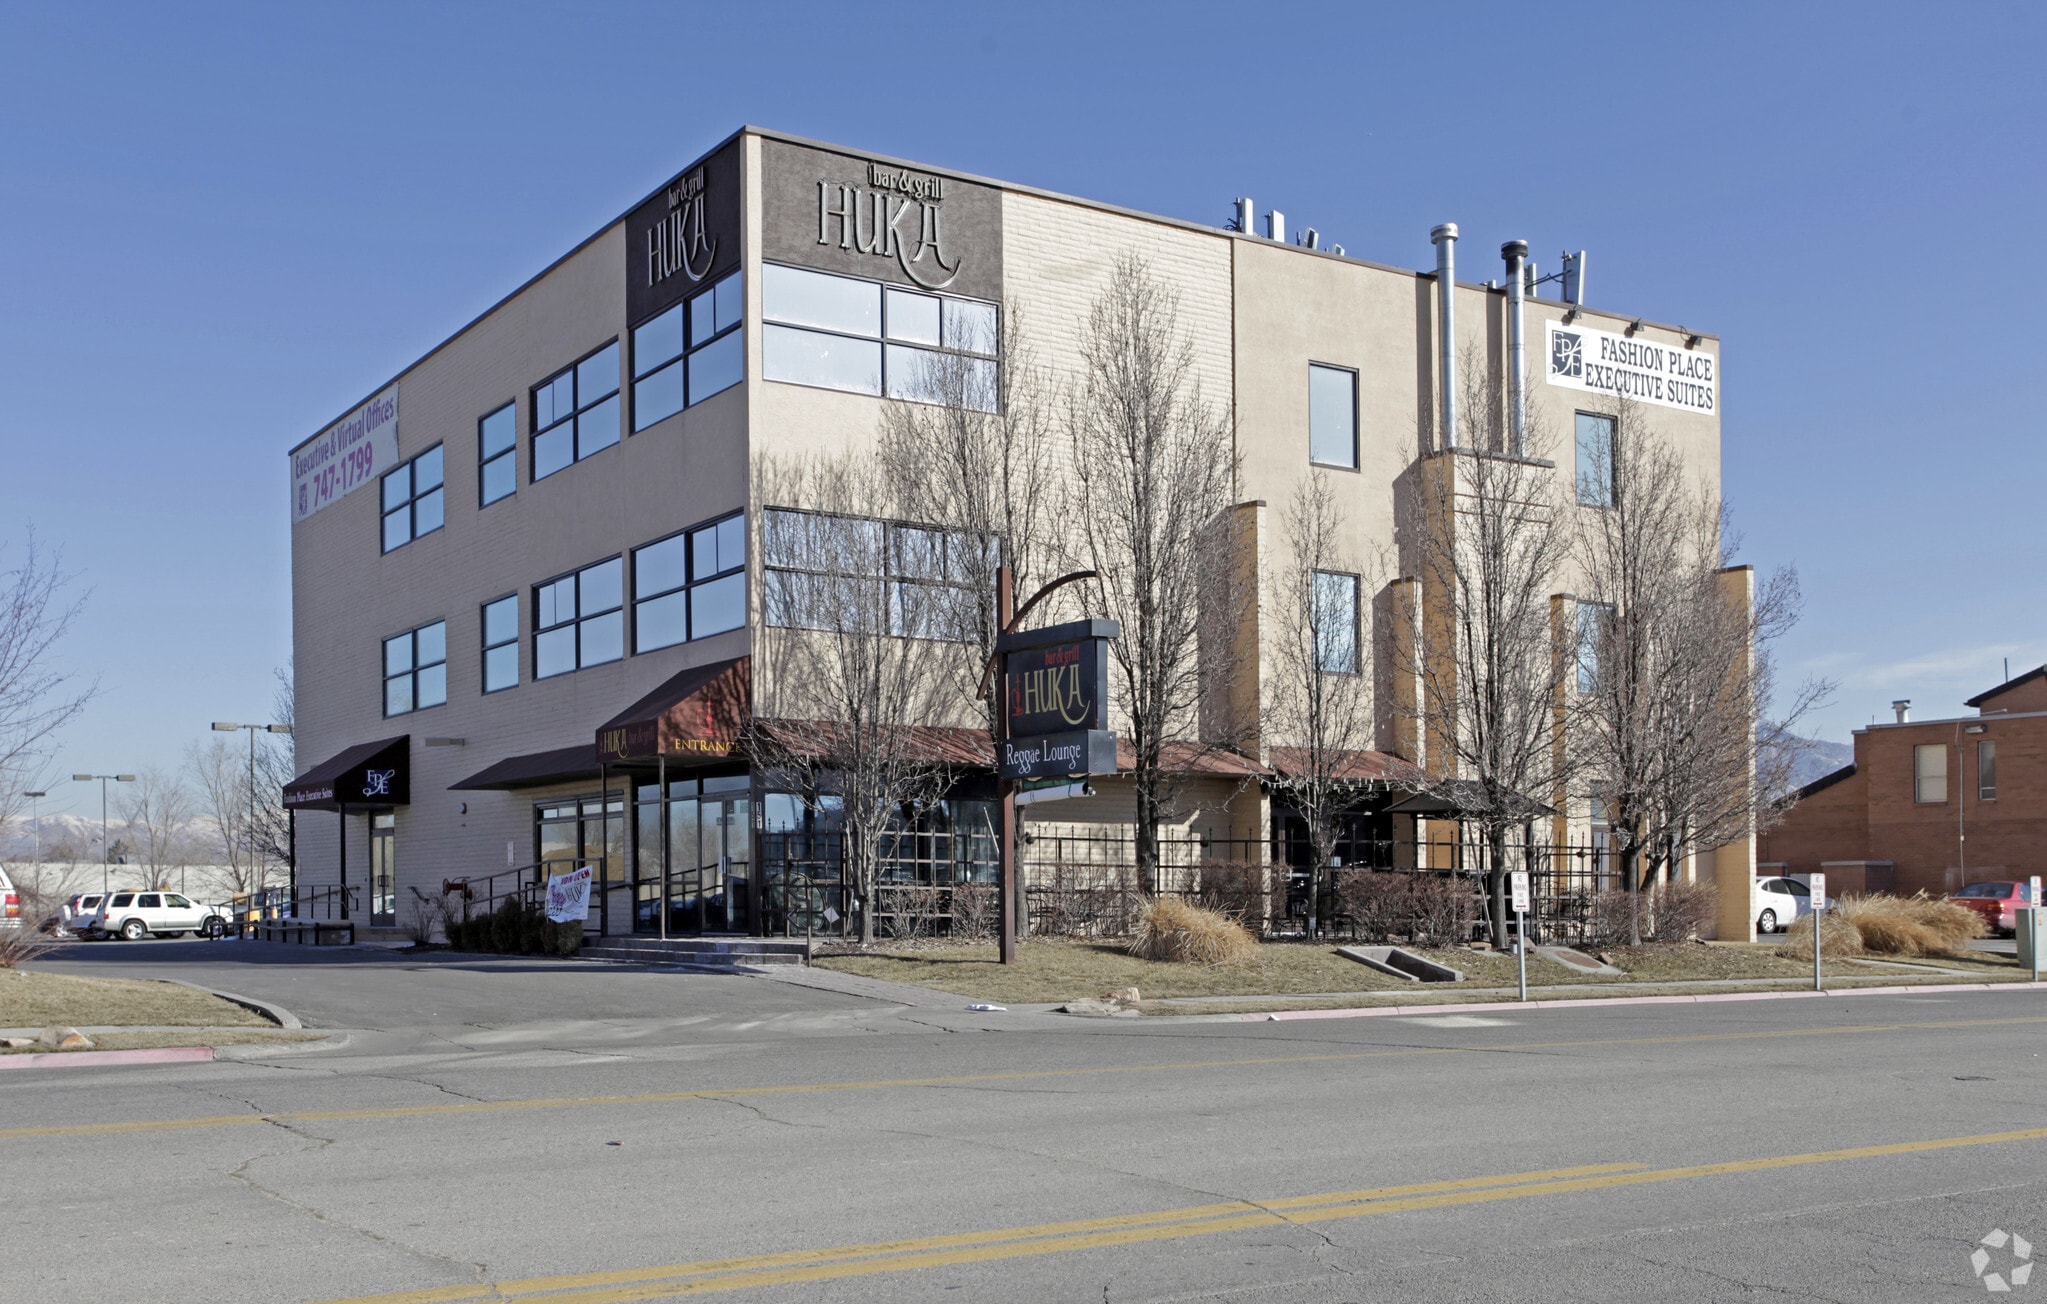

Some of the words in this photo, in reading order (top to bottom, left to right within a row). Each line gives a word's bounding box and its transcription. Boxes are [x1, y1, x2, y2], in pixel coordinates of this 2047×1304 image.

[668, 187, 681, 209] bar
[681, 178, 688, 200] &
[688, 165, 704, 201] grill
[875, 161, 896, 189] bar
[899, 169, 912, 193] &
[914, 176, 943, 199] grill
[647, 192, 717, 288] HUKA
[818, 179, 962, 290] HUKA
[1601, 336, 1663, 372] FASHION
[1669, 350, 1713, 382] PLACE
[1585, 363, 1663, 400] EXECUTIVE
[1668, 379, 1713, 410] SUITES
[295, 440, 330, 479] Executive
[330, 431, 337, 457] &
[337, 409, 365, 452] Virtual
[366, 397, 395, 434] Offices
[313, 441, 373, 508] 747-1799
[1024, 664, 1090, 725] HUKA
[604, 729, 630, 758] HUKA
[675, 738, 741, 753] ENTRANCE
[1006, 743, 1041, 774] Reggae
[1043, 740, 1081, 769] Lounge
